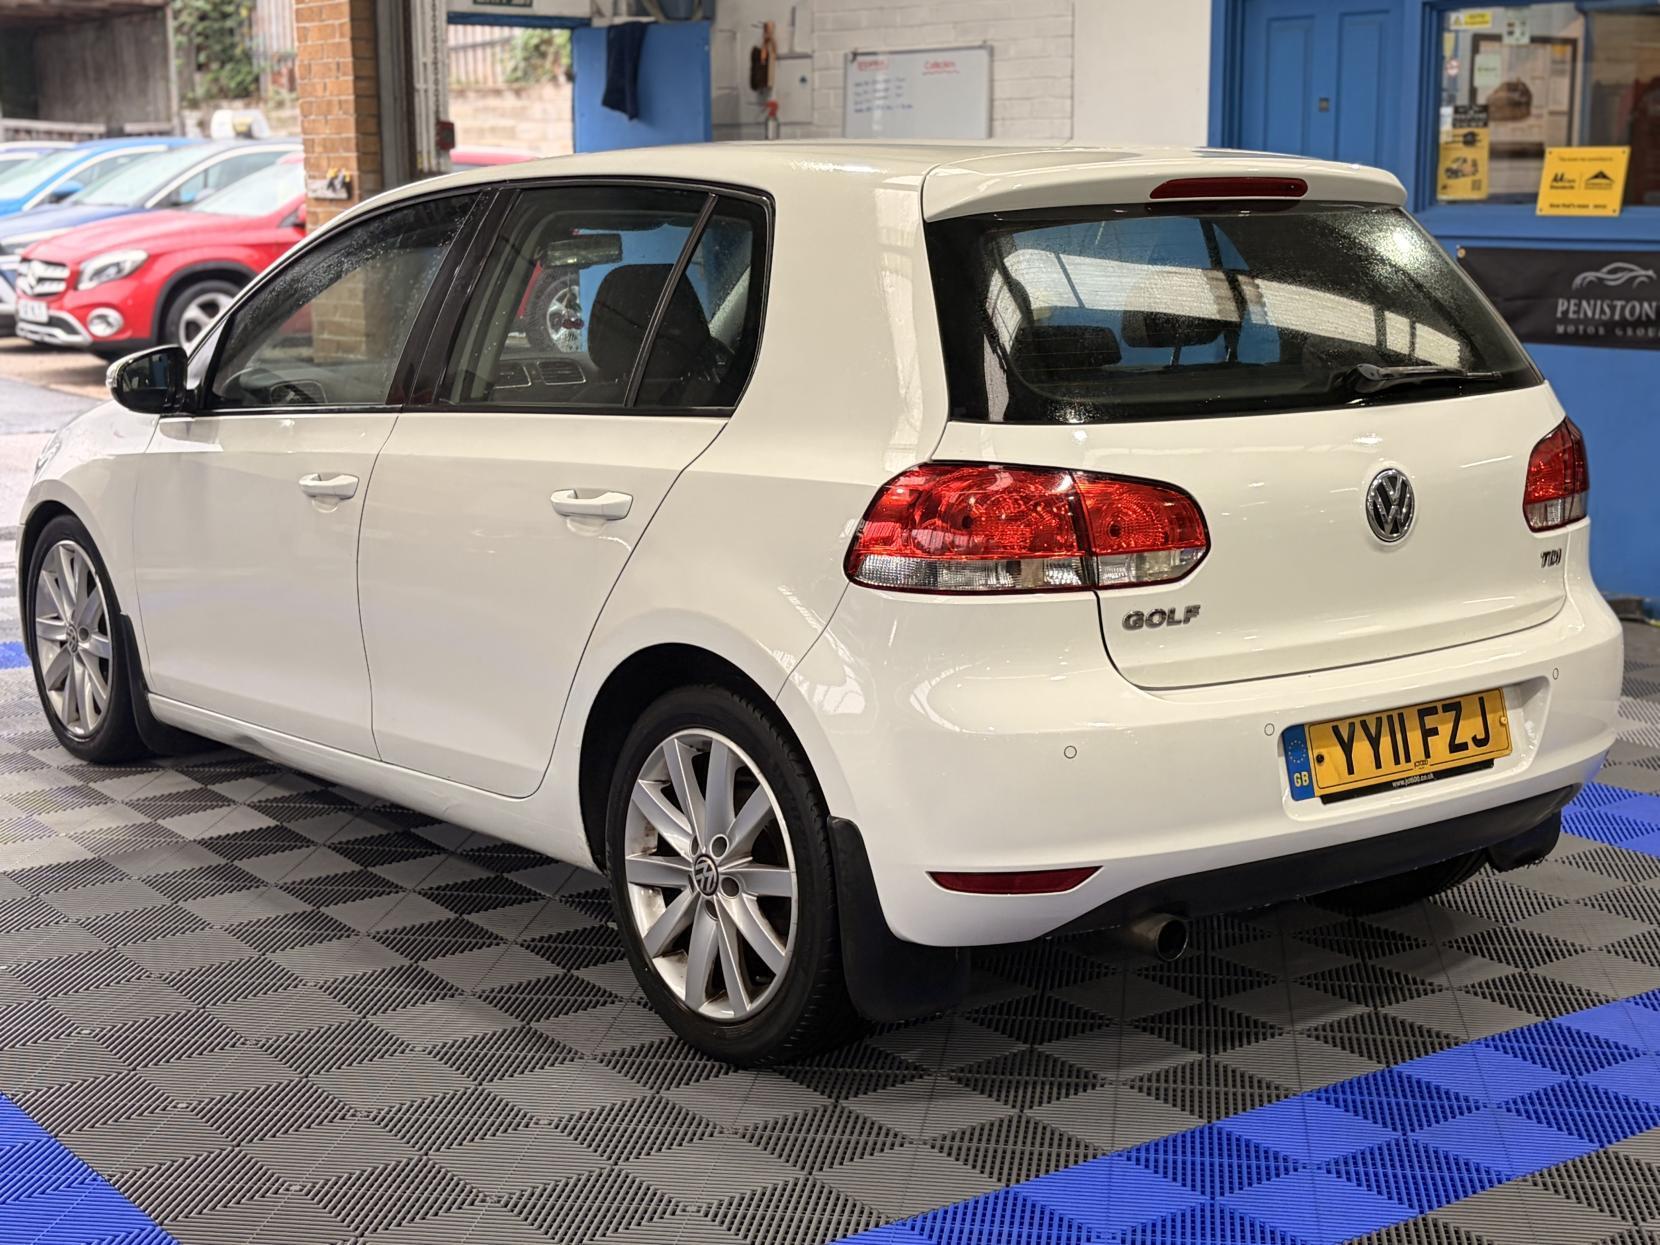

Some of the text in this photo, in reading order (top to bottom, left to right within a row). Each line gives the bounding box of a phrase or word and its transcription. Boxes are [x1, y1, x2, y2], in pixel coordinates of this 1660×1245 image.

[1556, 298, 1660, 321] PENISTON
[1555, 324, 1660, 338] MOTOR GROU
[1541, 548, 1562, 569] TDI
[1122, 604, 1201, 631] GOLF
[1416, 696, 1491, 759] FZJ
[1294, 770, 1310, 786] GB
